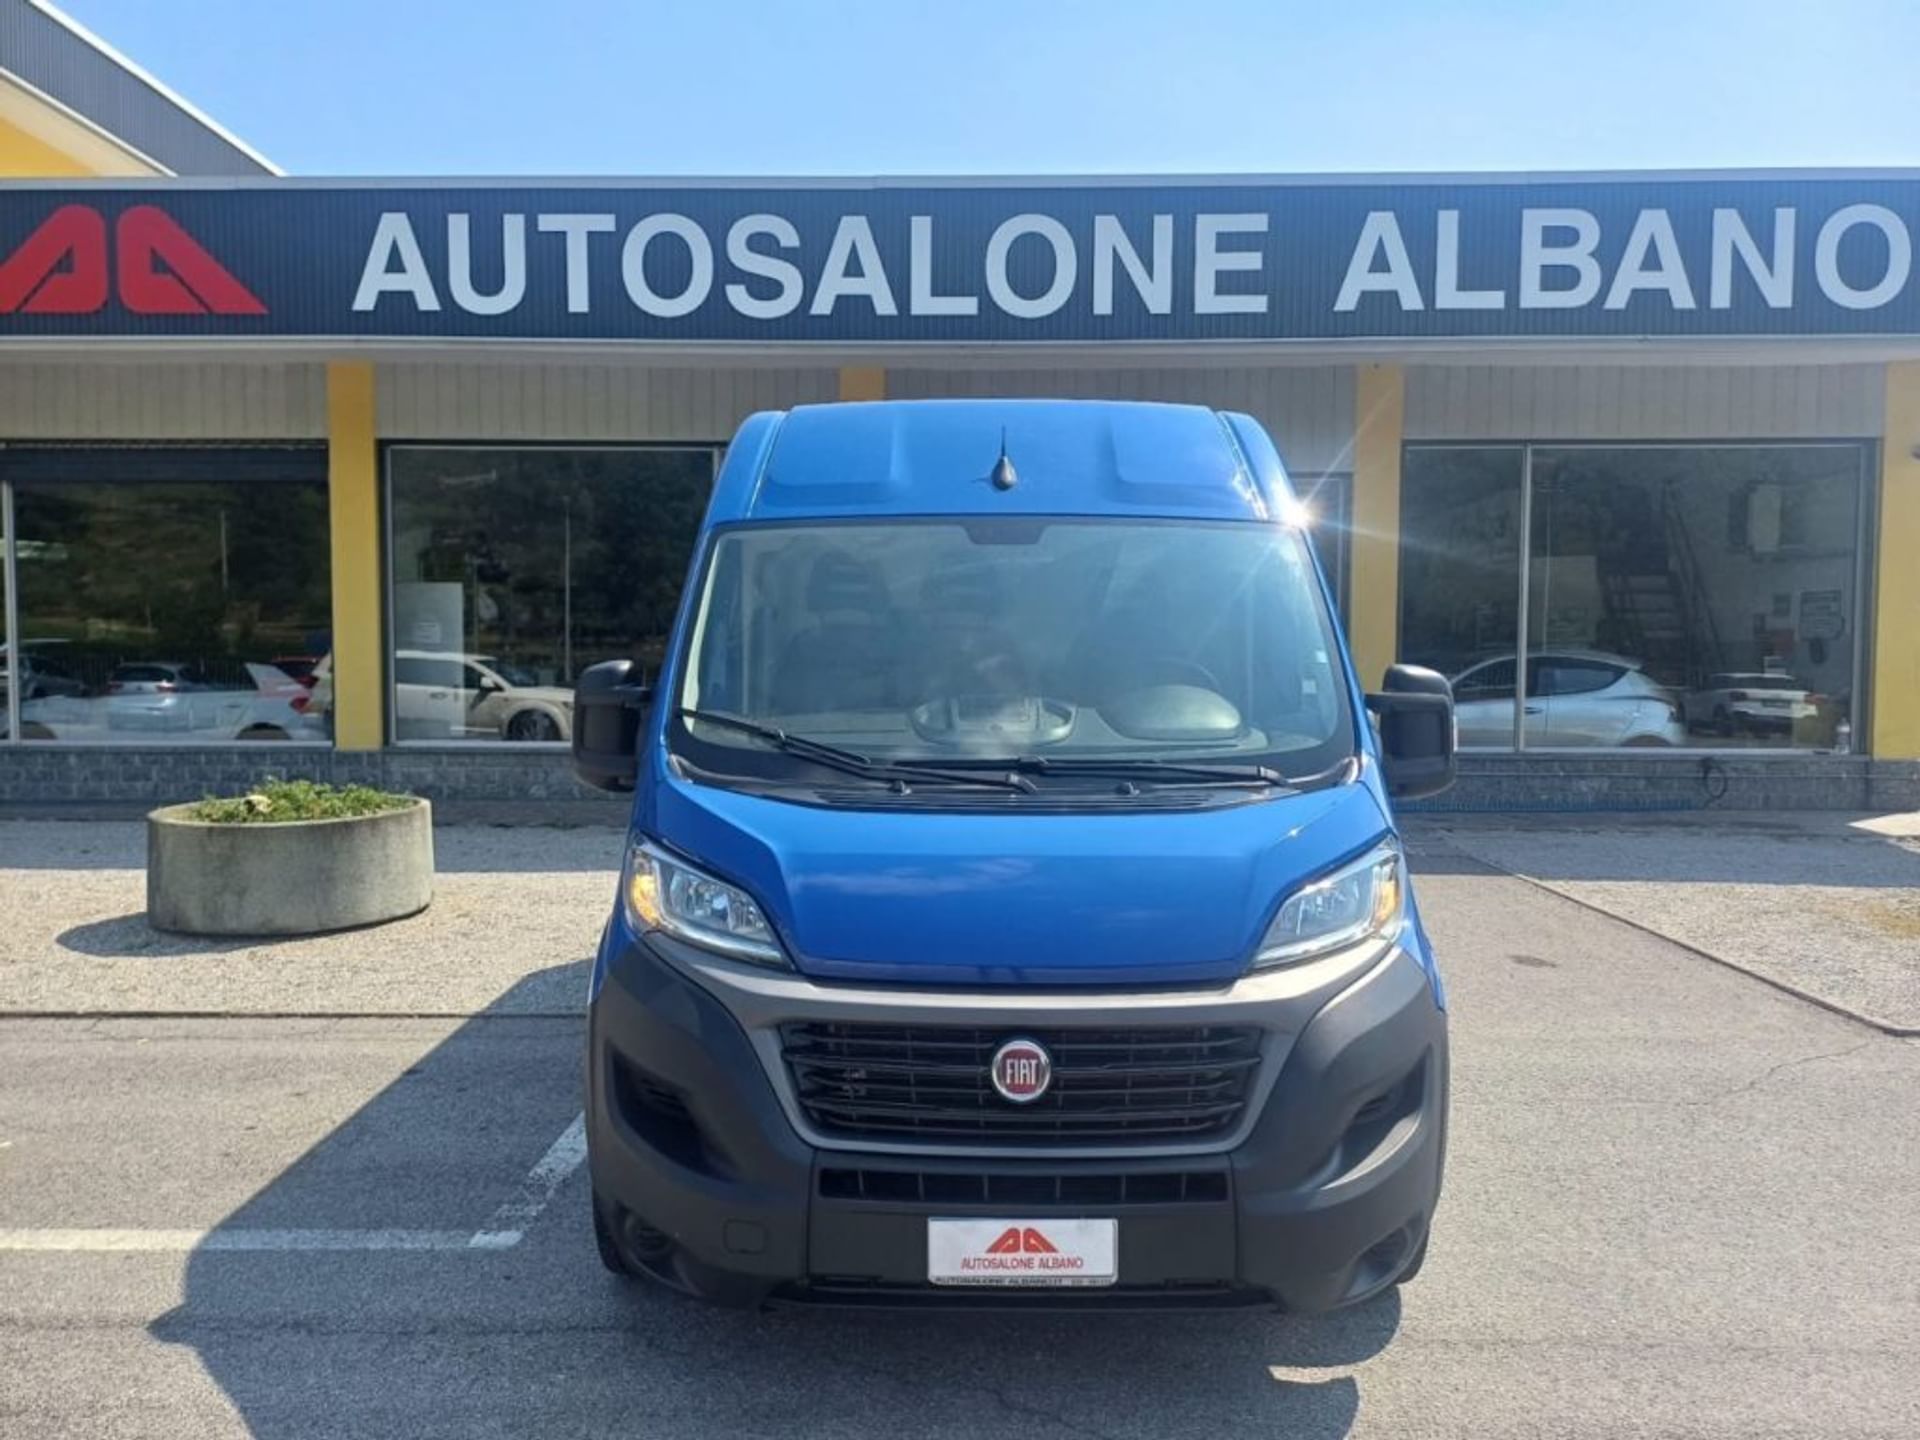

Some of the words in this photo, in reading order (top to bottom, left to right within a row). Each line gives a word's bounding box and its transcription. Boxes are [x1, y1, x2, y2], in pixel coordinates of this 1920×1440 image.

[352, 211, 1269, 319] AUTOSALONE
[1333, 203, 1912, 312] ALBANO
[1006, 1058, 1038, 1085] FIAT
[961, 1257, 1034, 1270] AUTOSALONE
[1038, 1257, 1083, 1270] ALBANO
